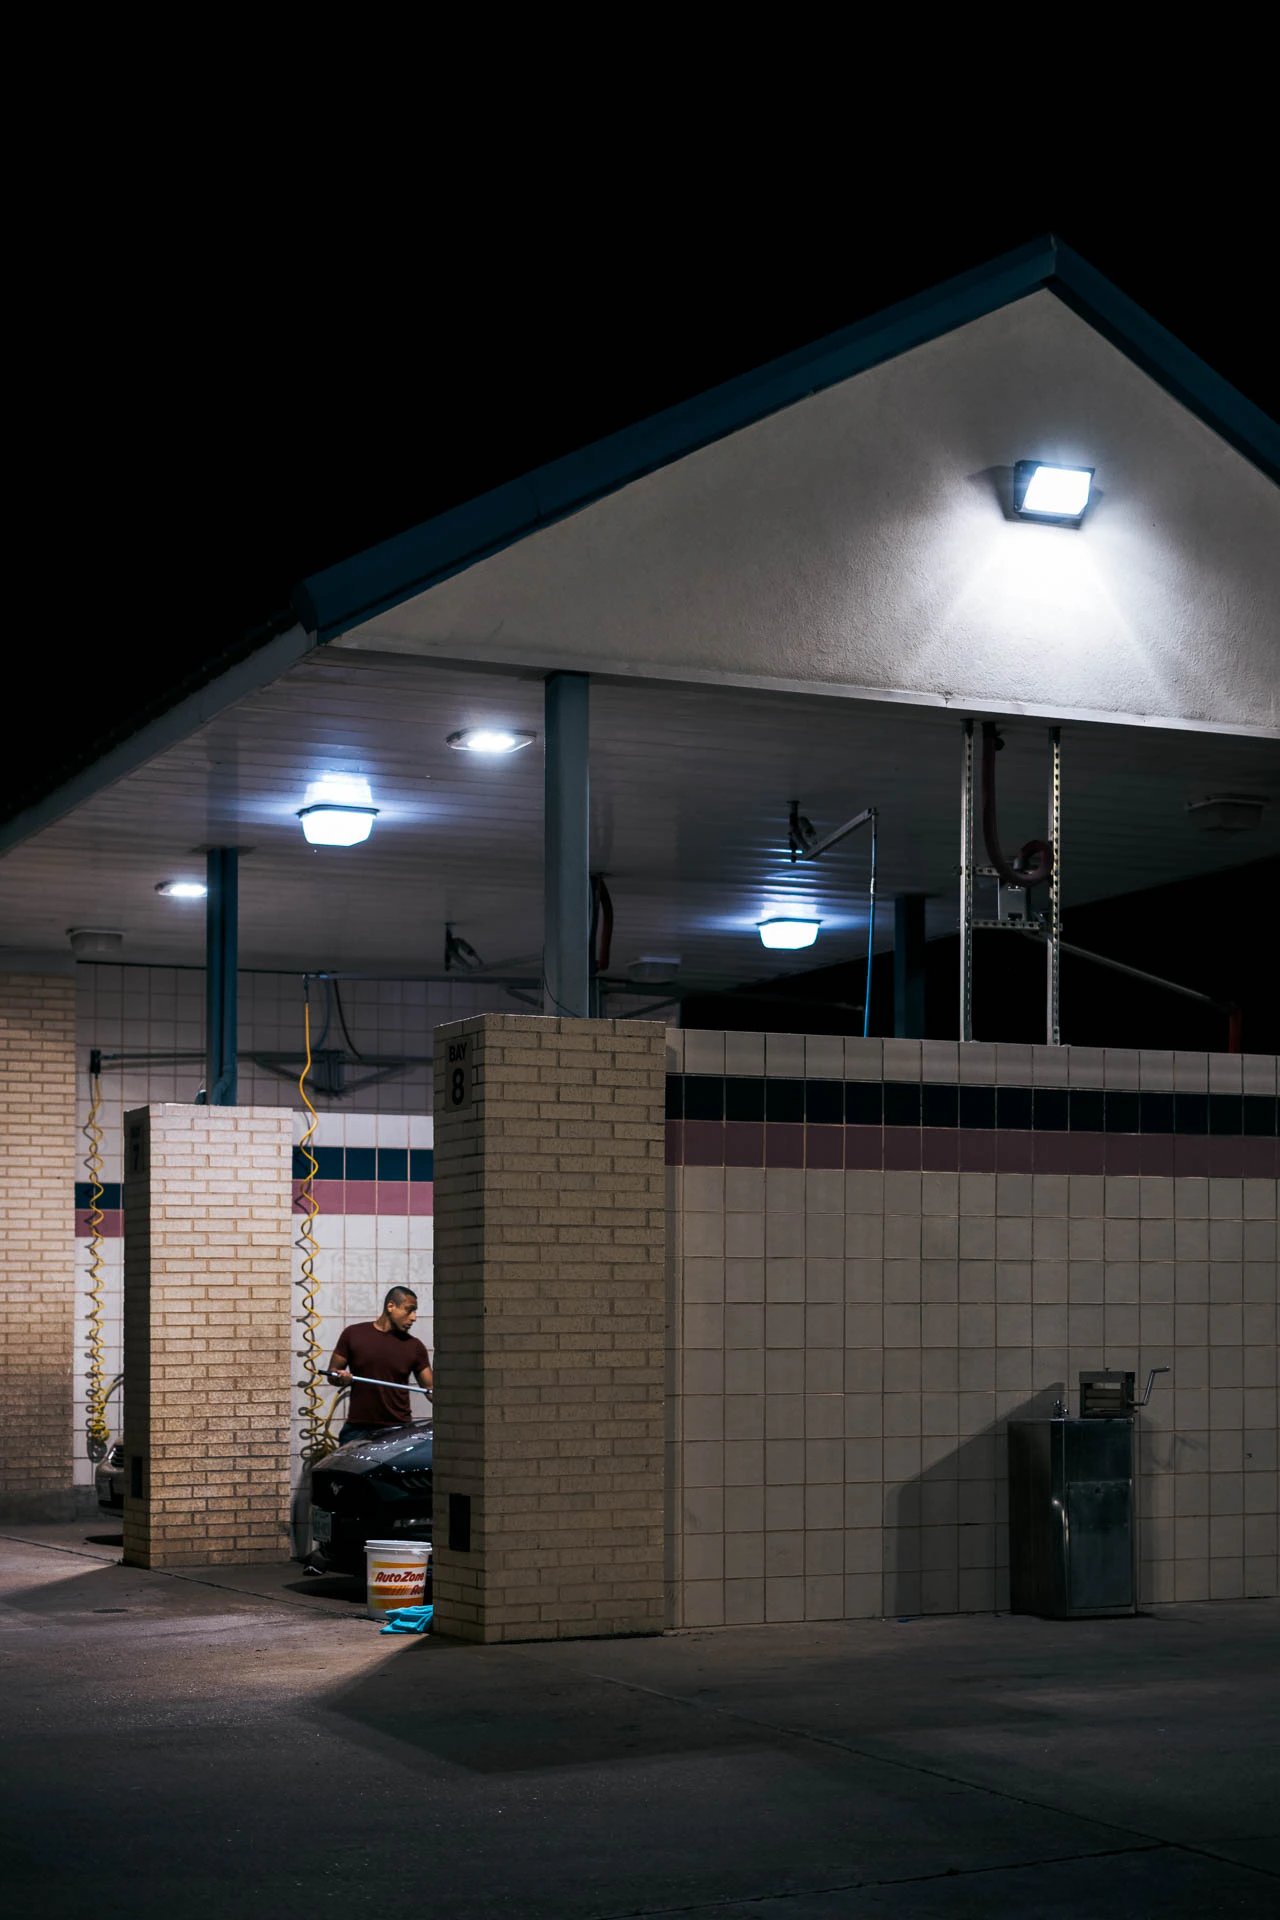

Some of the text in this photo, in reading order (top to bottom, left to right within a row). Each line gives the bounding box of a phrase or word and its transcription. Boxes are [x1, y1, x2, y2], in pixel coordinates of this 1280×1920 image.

[449, 1041, 467, 1062] BAY
[452, 1068, 464, 1105] 8
[375, 1571, 425, 1583] AutoZone
